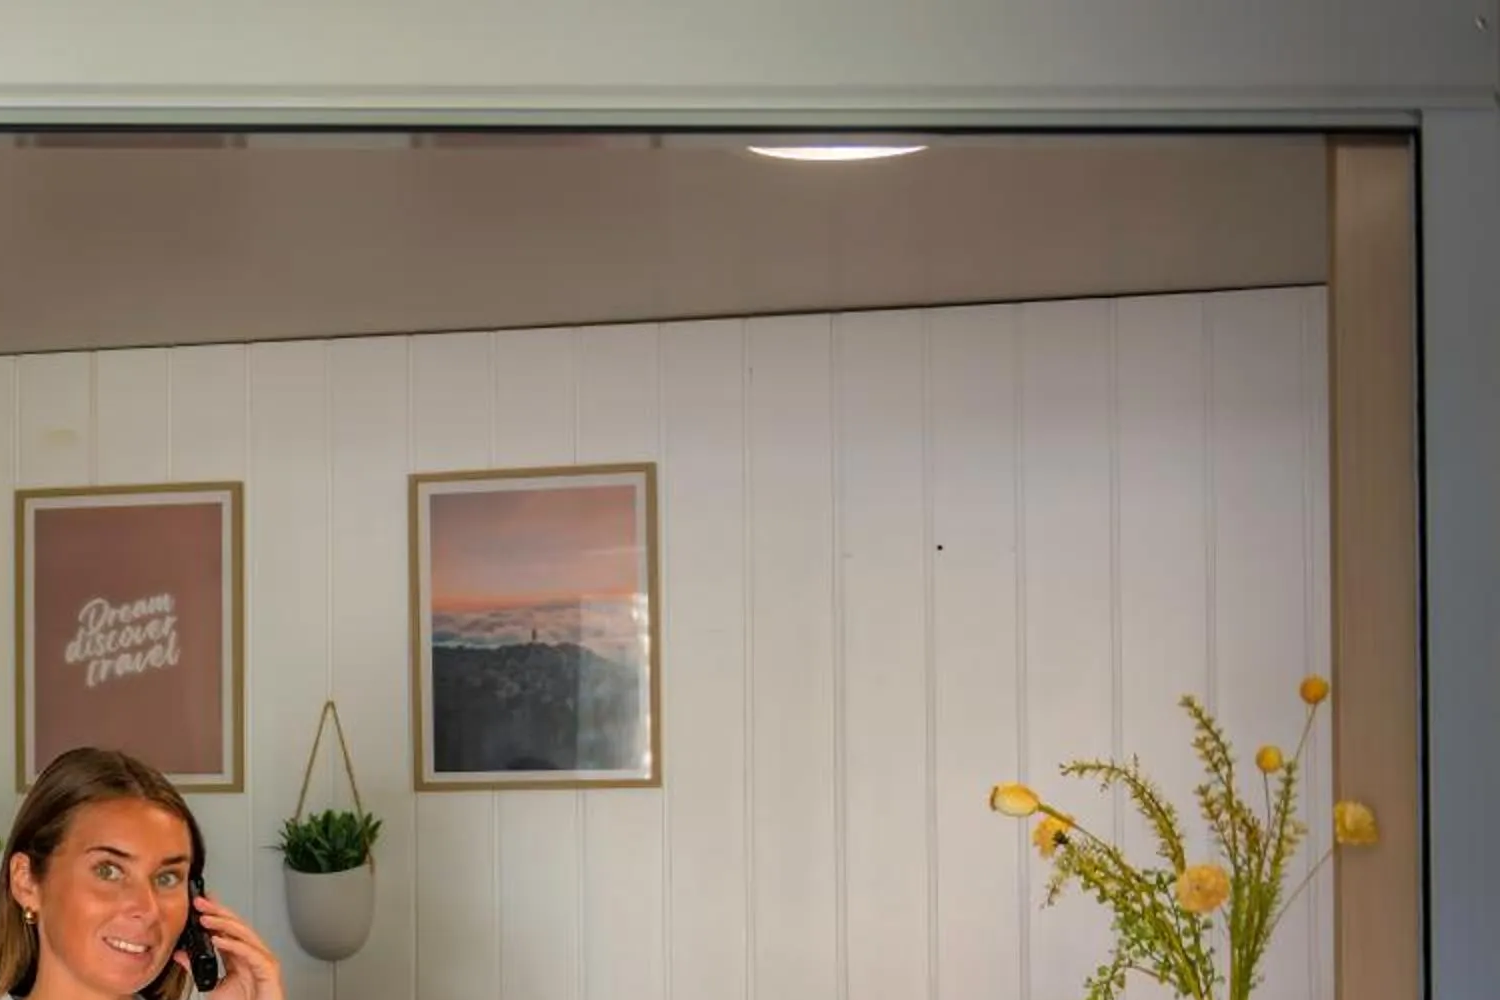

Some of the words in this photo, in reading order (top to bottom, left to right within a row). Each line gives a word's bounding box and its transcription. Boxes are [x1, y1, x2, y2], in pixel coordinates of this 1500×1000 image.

[78, 593, 175, 635] Dream
[64, 616, 178, 665] discover
[85, 630, 181, 688] travel
